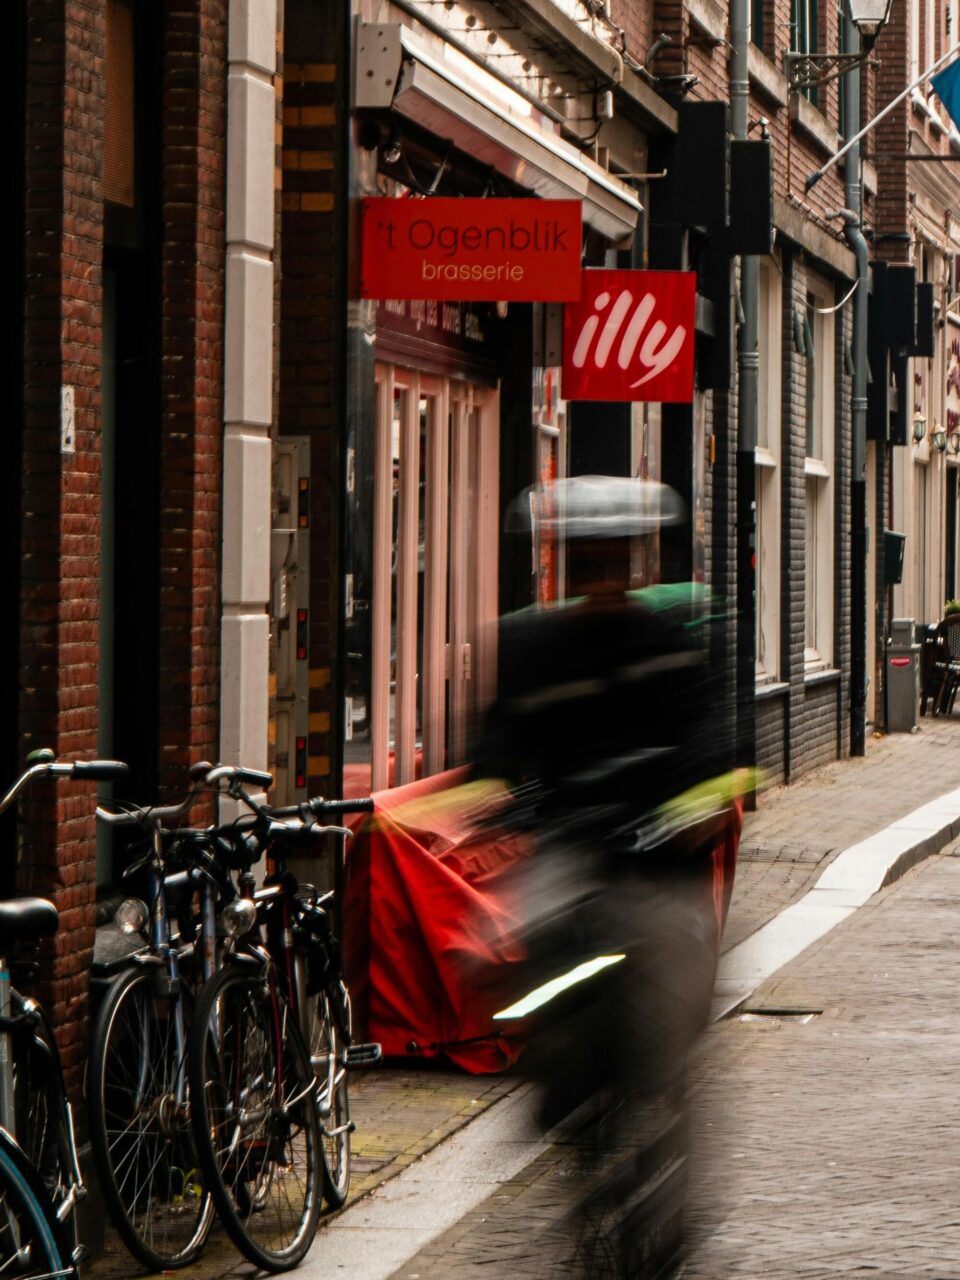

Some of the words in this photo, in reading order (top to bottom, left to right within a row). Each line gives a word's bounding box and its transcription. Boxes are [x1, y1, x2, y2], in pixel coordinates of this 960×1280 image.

[408, 219, 569, 257] Ogenblik
[422, 259, 524, 281] brasserie
[572, 289, 687, 389] illy
